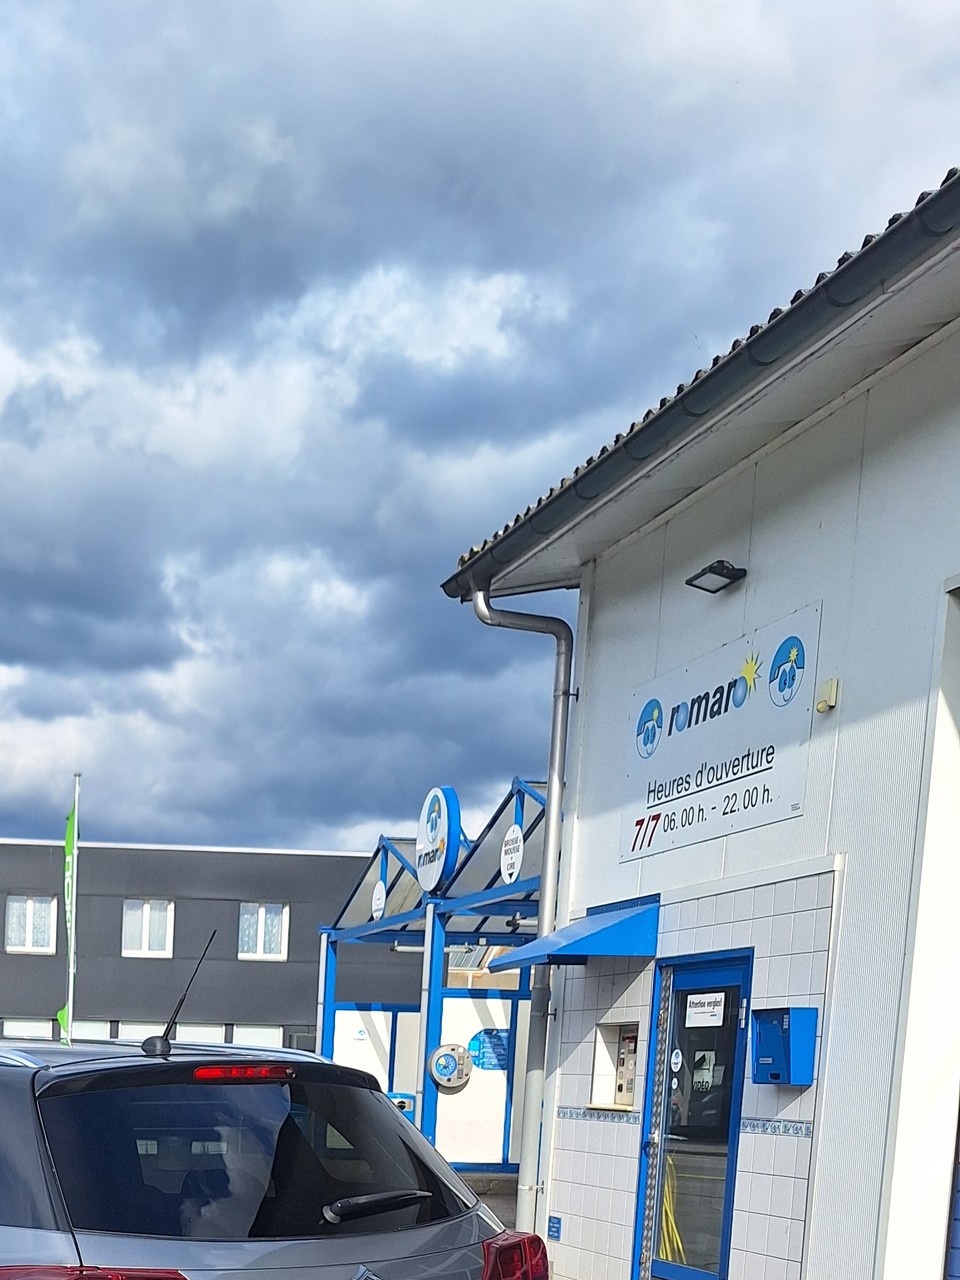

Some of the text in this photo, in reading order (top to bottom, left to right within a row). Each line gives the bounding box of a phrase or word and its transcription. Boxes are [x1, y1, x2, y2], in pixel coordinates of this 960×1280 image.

[667, 675, 748, 737] romaro
[647, 744, 775, 804] Heures d'ouverture
[631, 813, 662, 852] 7/7
[697, 803, 707, 824] h.
[761, 784, 773, 805] h.
